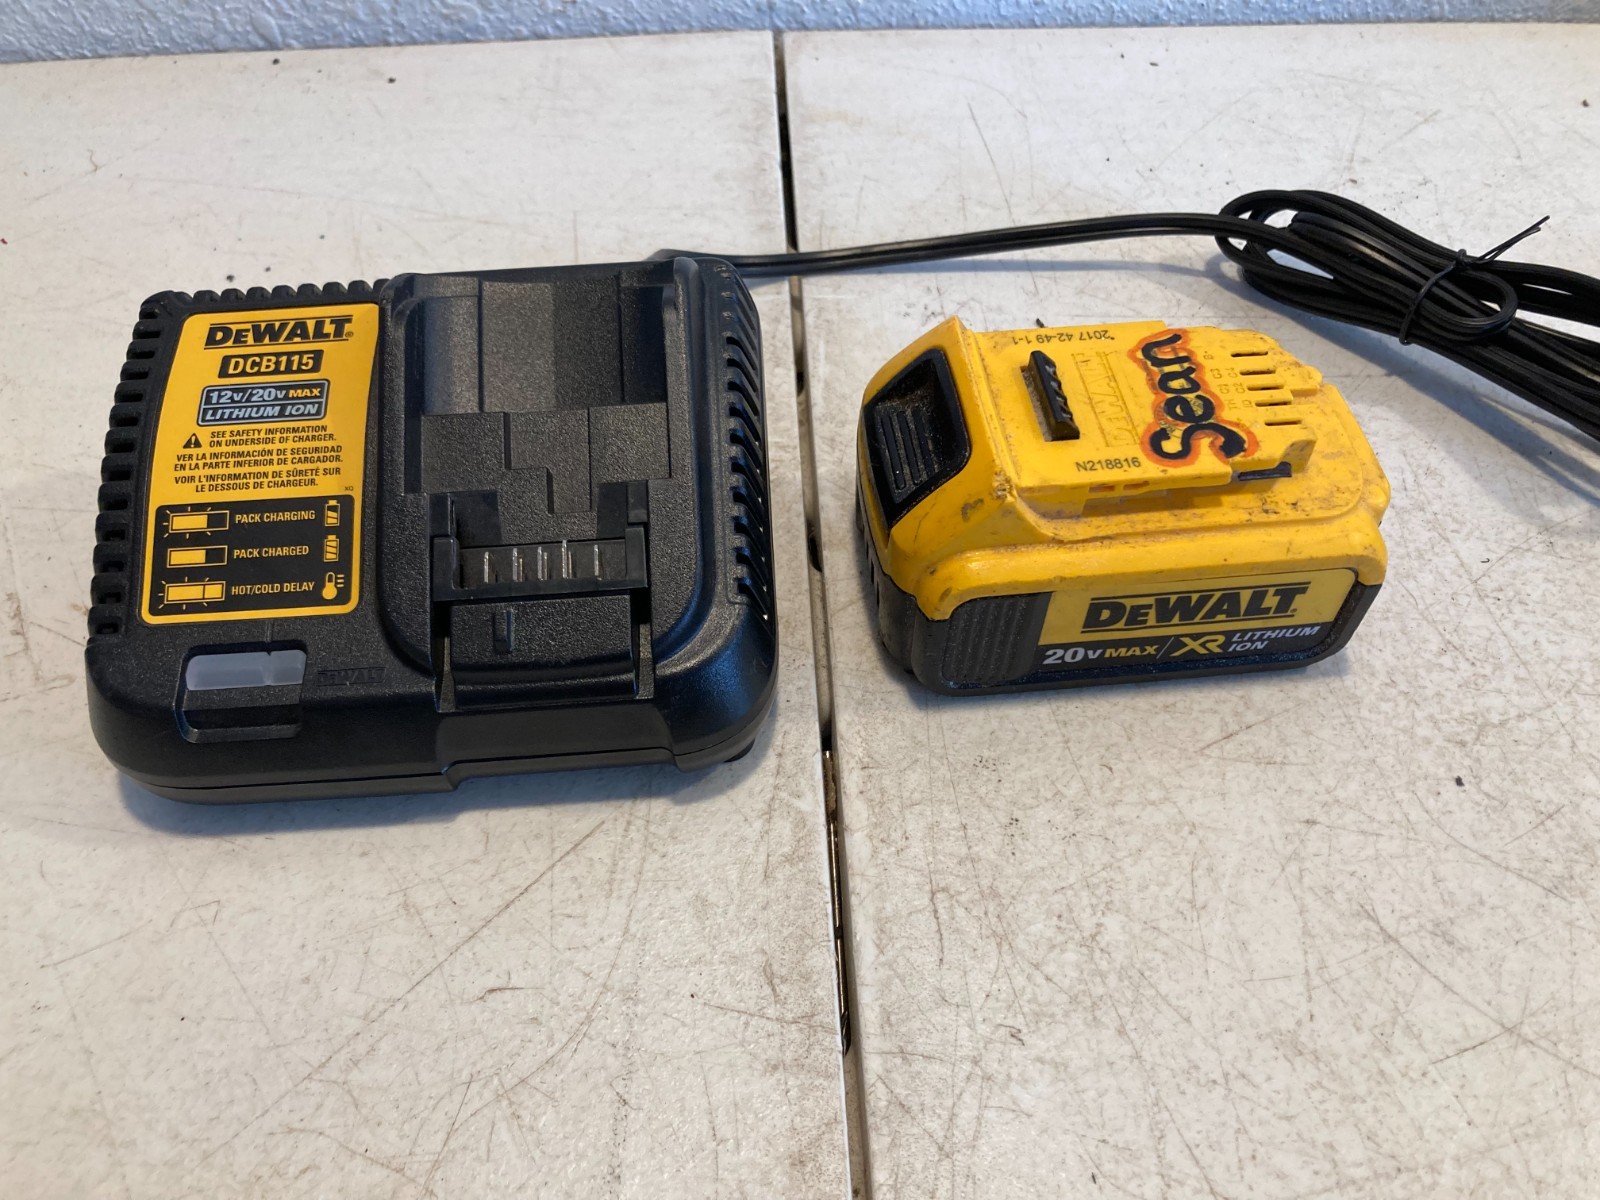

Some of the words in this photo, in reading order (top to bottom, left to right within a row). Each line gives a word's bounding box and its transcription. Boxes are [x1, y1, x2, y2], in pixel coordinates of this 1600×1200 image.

[1036, 332, 1073, 344] 42-49
[228, 353, 314, 375] DCB115
[288, 388, 321, 398] MAX
[1141, 333, 1246, 460] Sean
[205, 405, 280, 420] LITHIUM
[284, 404, 319, 416] ION
[228, 428, 263, 438] SAFETY
[264, 425, 328, 436] INFORMATION
[209, 440, 223, 448] ON
[225, 436, 277, 446] UNDERSIDE
[278, 436, 291, 444] OF
[292, 434, 336, 443] CHARGER.
[176, 454, 194, 462] VER
[196, 452, 207, 461] LA
[210, 448, 273, 460] INFORMACIÓN
[276, 448, 288, 456] DE
[290, 445, 342, 456] SEGURIDAD
[174, 464, 186, 472] EN
[188, 462, 200, 471] LA
[202, 461, 231, 470] PARTE
[233, 458, 274, 468] INFERIOR
[276, 457, 289, 466] DE
[291, 455, 343, 464] CARGADOR.
[1075, 457, 1141, 472] N218816
[174, 476, 196, 484] VOIR
[198, 472, 270, 483] L'INFORMATION
[286, 466, 320, 478] SÛRETÉ
[322, 468, 341, 476] SUR
[195, 485, 206, 493] LE
[208, 482, 250, 492] DESSOUS
[253, 482, 264, 490] DE
[267, 478, 318, 488] CHARGEUR.
[235, 513, 261, 524] PACK
[264, 510, 316, 522] CHARGING
[233, 548, 260, 559] PACK
[262, 546, 309, 557] CHARGED
[231, 584, 280, 595] HOT/COLD
[283, 582, 315, 592] DELAY
[1231, 625, 1321, 642] LITHIUM
[1104, 644, 1160, 658] MAX
[1170, 634, 1226, 657] XR
[1228, 640, 1268, 652] ION
